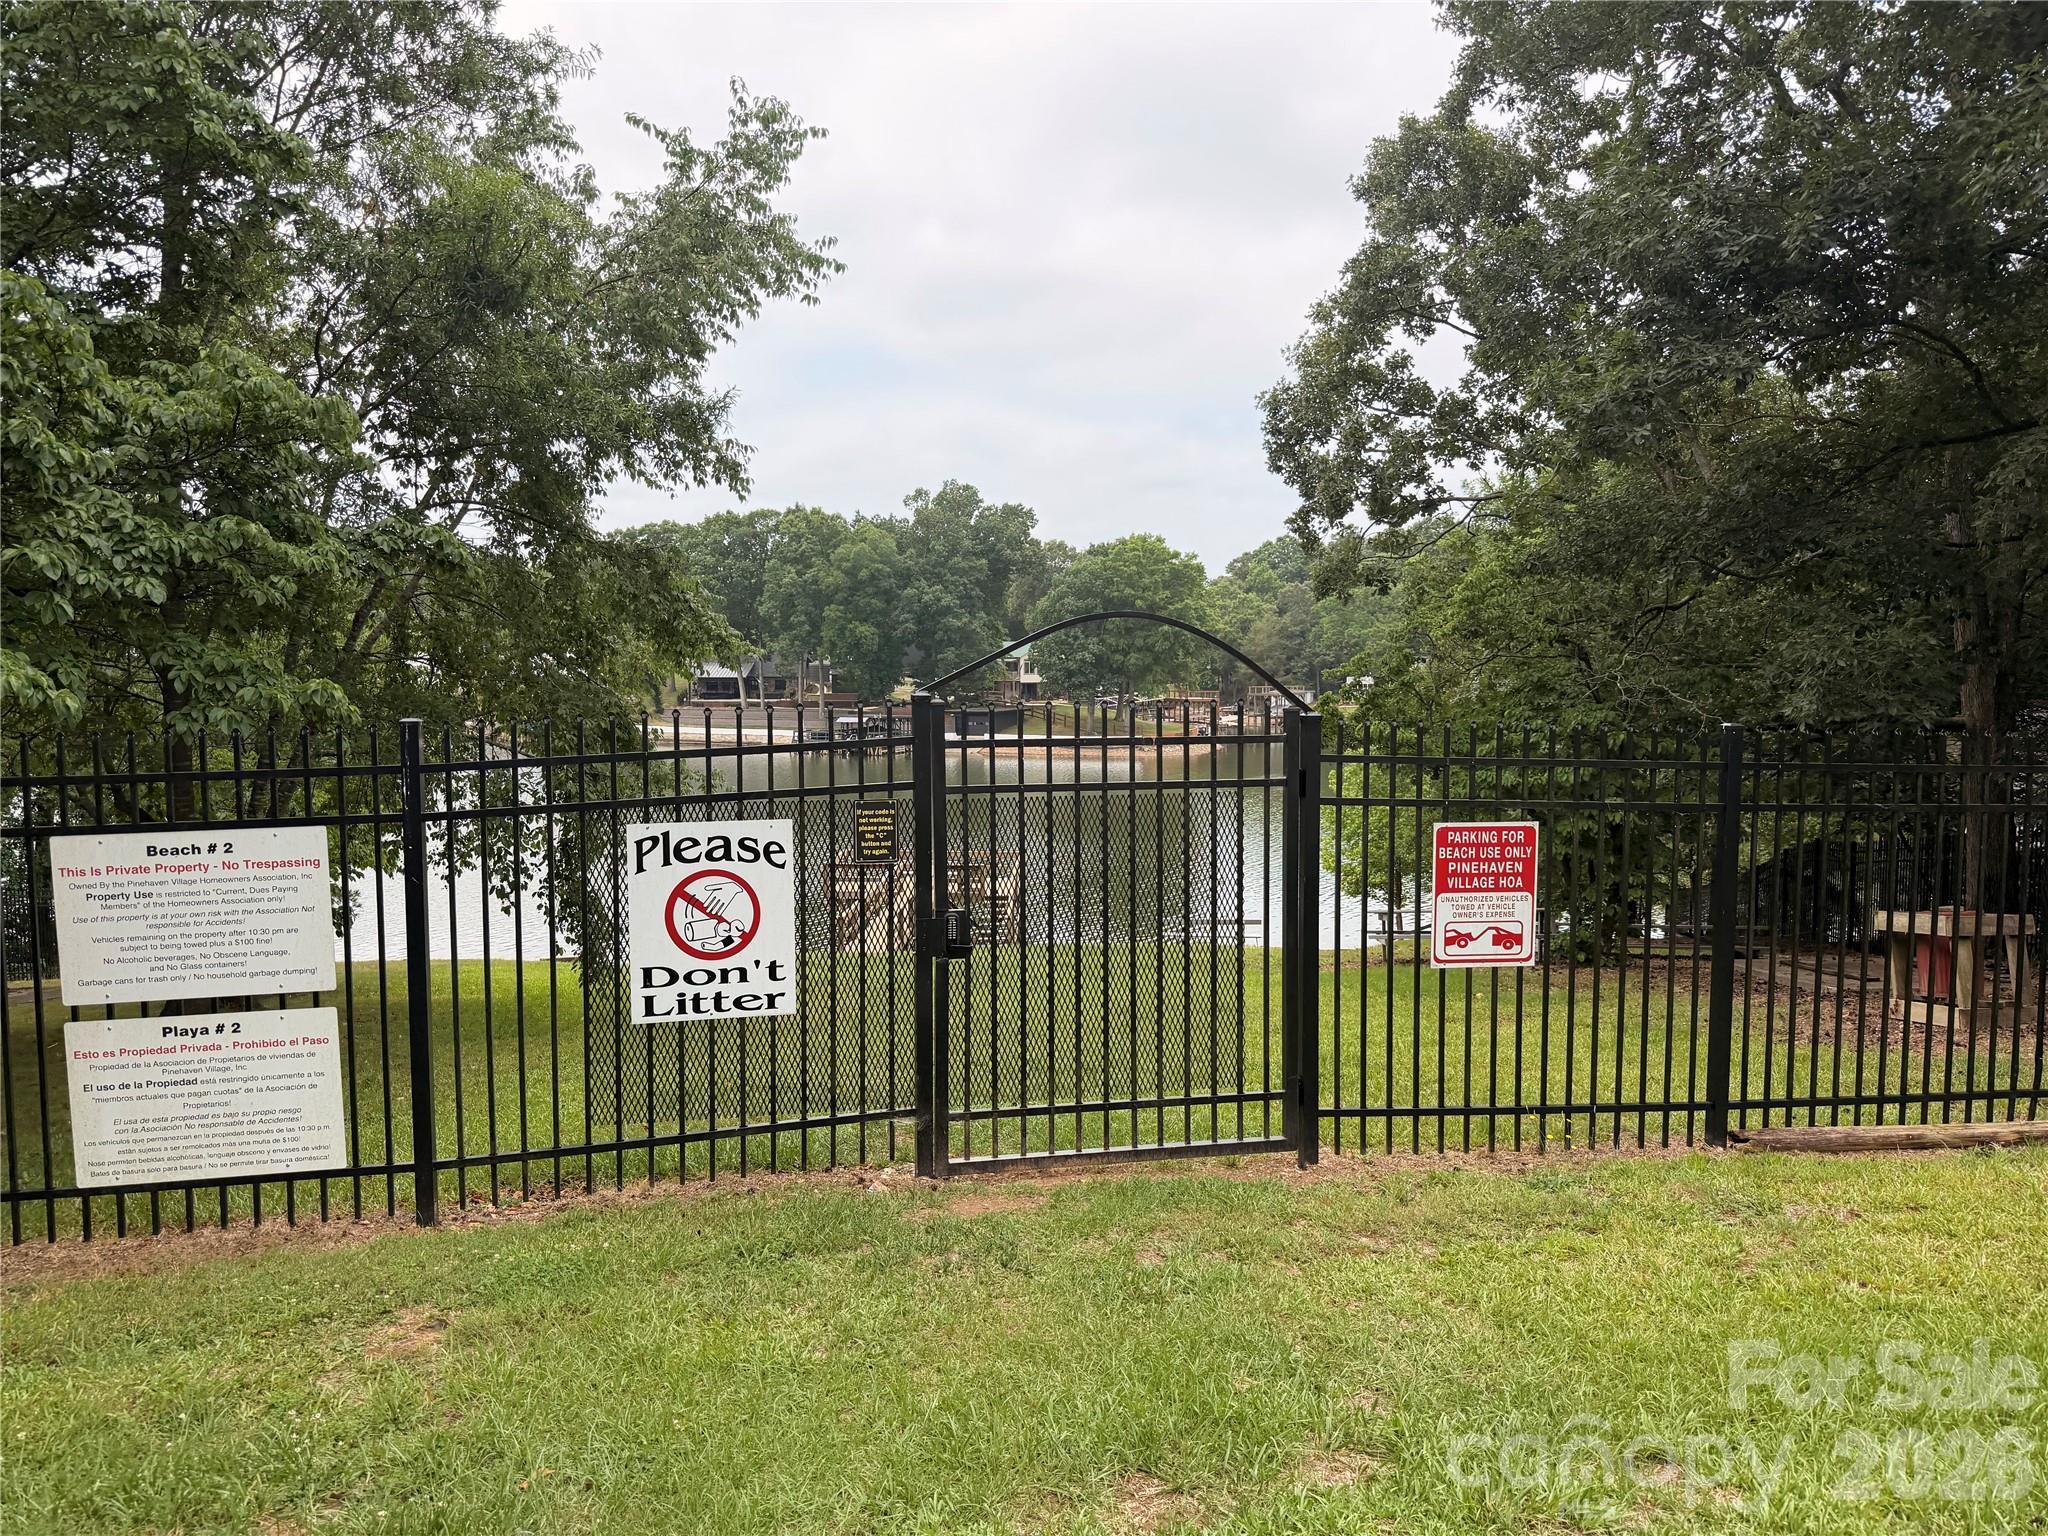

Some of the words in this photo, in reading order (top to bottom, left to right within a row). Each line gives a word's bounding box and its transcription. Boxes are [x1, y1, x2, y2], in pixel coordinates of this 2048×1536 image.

[1448, 831, 1497, 844] PARKING
[1502, 831, 1524, 843] FOR
[146, 844, 201, 856] Beach
[207, 843, 217, 854] #
[224, 843, 233, 853] 2
[634, 830, 786, 875] Please
[1439, 848, 1475, 859] BEACH
[1480, 847, 1500, 858] USE
[1505, 847, 1532, 858] ONLY
[58, 867, 86, 877] This
[91, 867, 101, 876] Is
[106, 865, 150, 875] Private
[155, 863, 209, 874] Property
[222, 861, 239, 870] No
[243, 858, 320, 870] Trespassing
[1449, 862, 1522, 873] PINEHAVEN
[200, 875, 250, 883] Homeowners
[1448, 877, 1495, 888] VILLAGE
[1500, 876, 1523, 887] HOA
[86, 893, 130, 902] Property
[165, 890, 200, 898] restricted
[117, 914, 149, 922] property
[146, 921, 190, 930] responsible
[120, 944, 148, 952] subject
[249, 969, 280, 978] garbage
[640, 960, 786, 989] Don't
[642, 991, 785, 1018] Litter
[162, 1026, 209, 1038] Playa
[216, 1023, 225, 1034] #
[231, 1023, 241, 1033] 2
[74, 1051, 99, 1059] Esto
[120, 1046, 176, 1057] Propiedad
[180, 1043, 222, 1052] Privada
[233, 1039, 286, 1049] Prohibido
[302, 1037, 329, 1045] Paso
[90, 1063, 129, 1071] Propiedad
[146, 1078, 197, 1088] Propiedad
